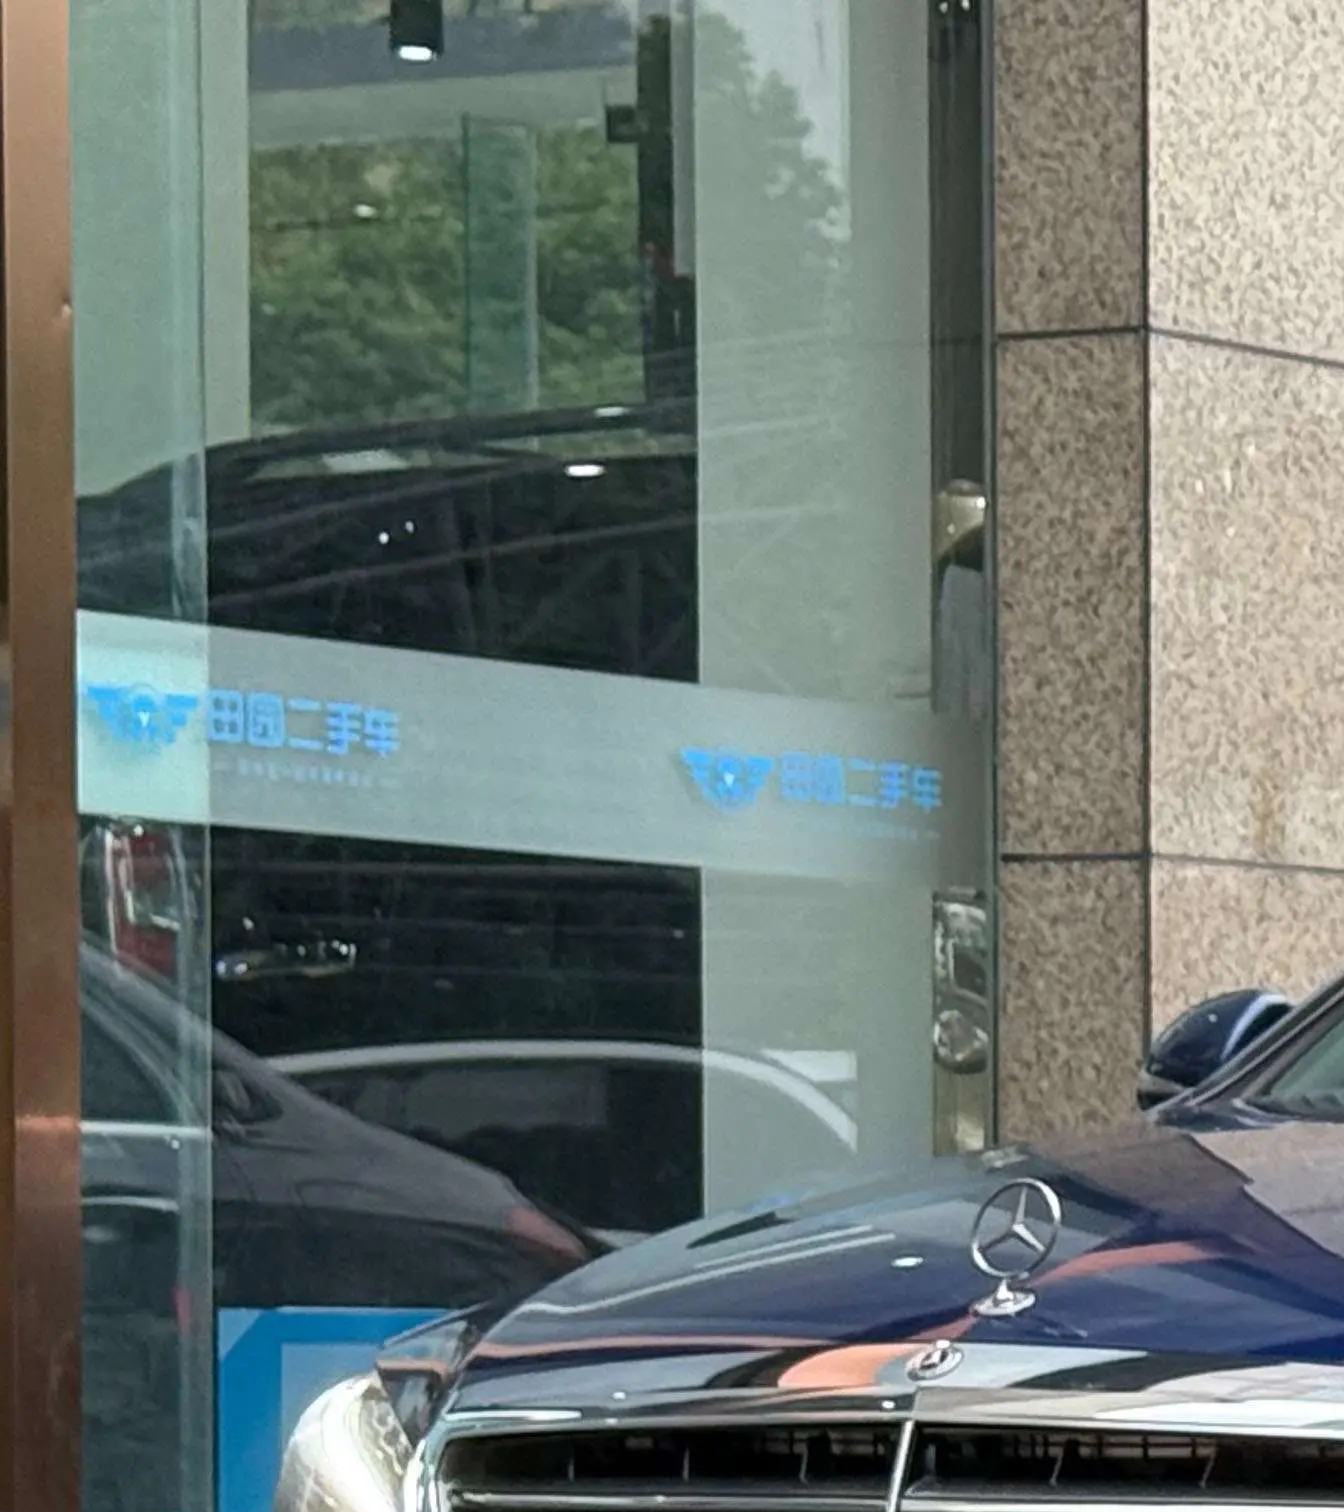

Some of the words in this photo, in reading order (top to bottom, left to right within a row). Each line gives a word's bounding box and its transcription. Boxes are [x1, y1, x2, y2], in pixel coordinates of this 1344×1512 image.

[208, 689, 399, 758] 田园二手车
